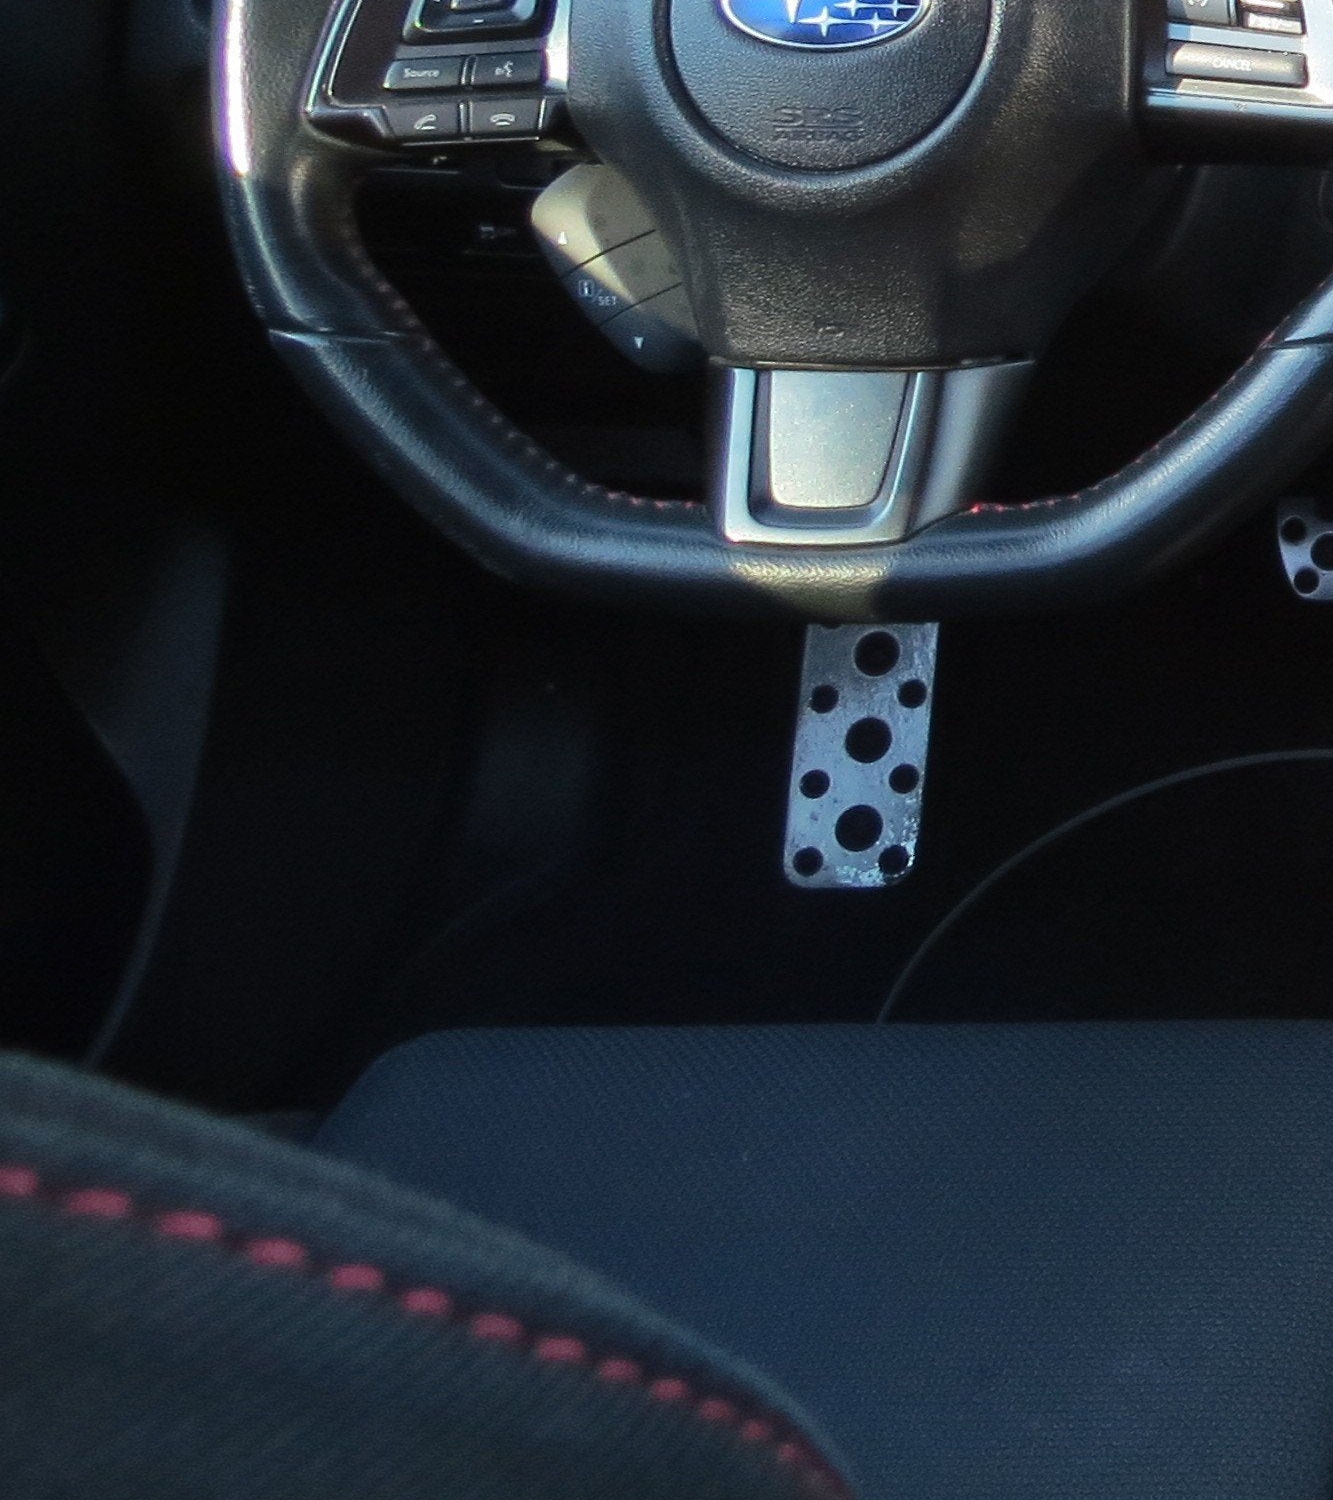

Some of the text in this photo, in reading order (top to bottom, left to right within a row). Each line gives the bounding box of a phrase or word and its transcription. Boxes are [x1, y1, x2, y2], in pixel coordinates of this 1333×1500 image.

[1212, 55, 1253, 72] CANCEL
[402, 67, 441, 79] Source
[772, 106, 863, 126] SRS
